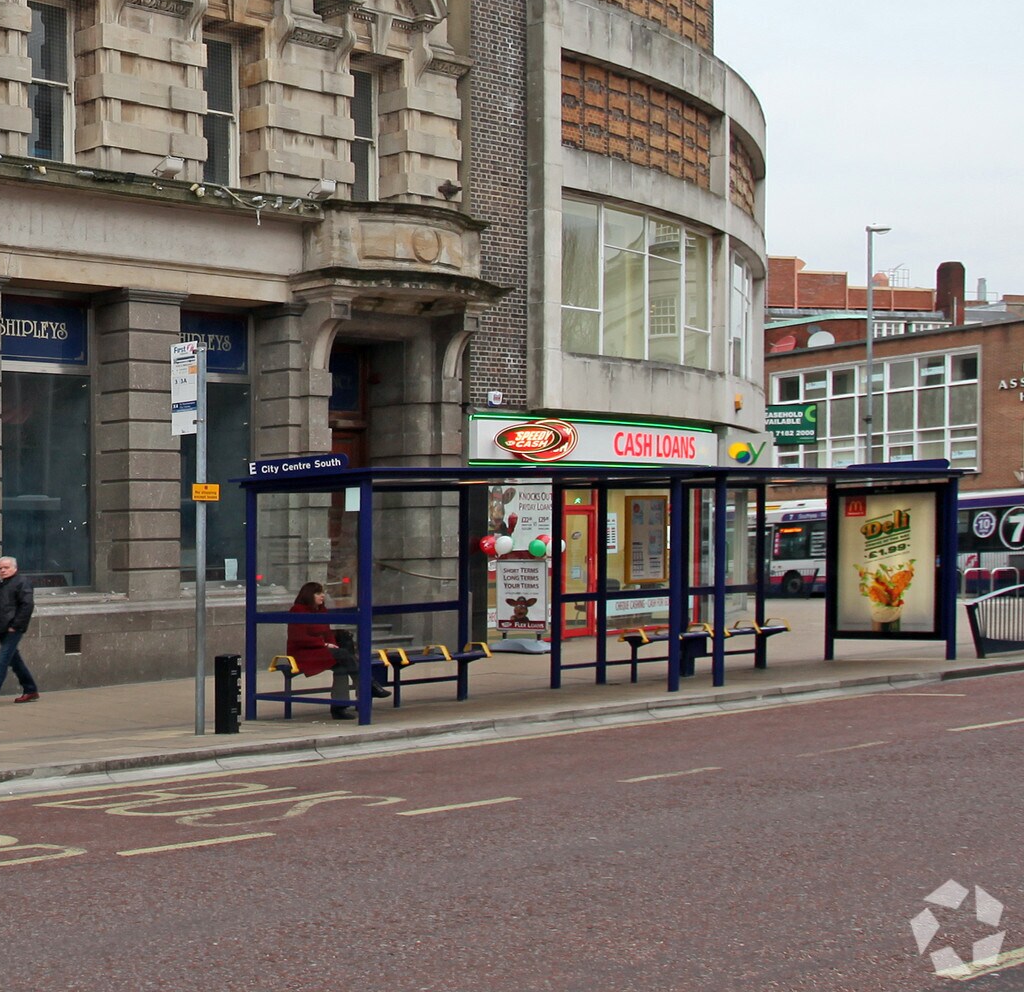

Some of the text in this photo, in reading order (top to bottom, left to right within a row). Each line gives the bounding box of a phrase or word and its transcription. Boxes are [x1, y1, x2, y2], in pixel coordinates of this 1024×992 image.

[174, 346, 186, 354] First
[515, 430, 554, 441] SPEEDY
[516, 440, 549, 448] CASH
[614, 431, 696, 459] CASH LOANS
[248, 458, 341, 475] E City Centre South
[519, 492, 540, 500] KNOCKS
[860, 509, 910, 540] Deli
[978, 519, 990, 529] 10
[1008, 513, 1024, 542] 7
[868, 543, 906, 559] £1.99
